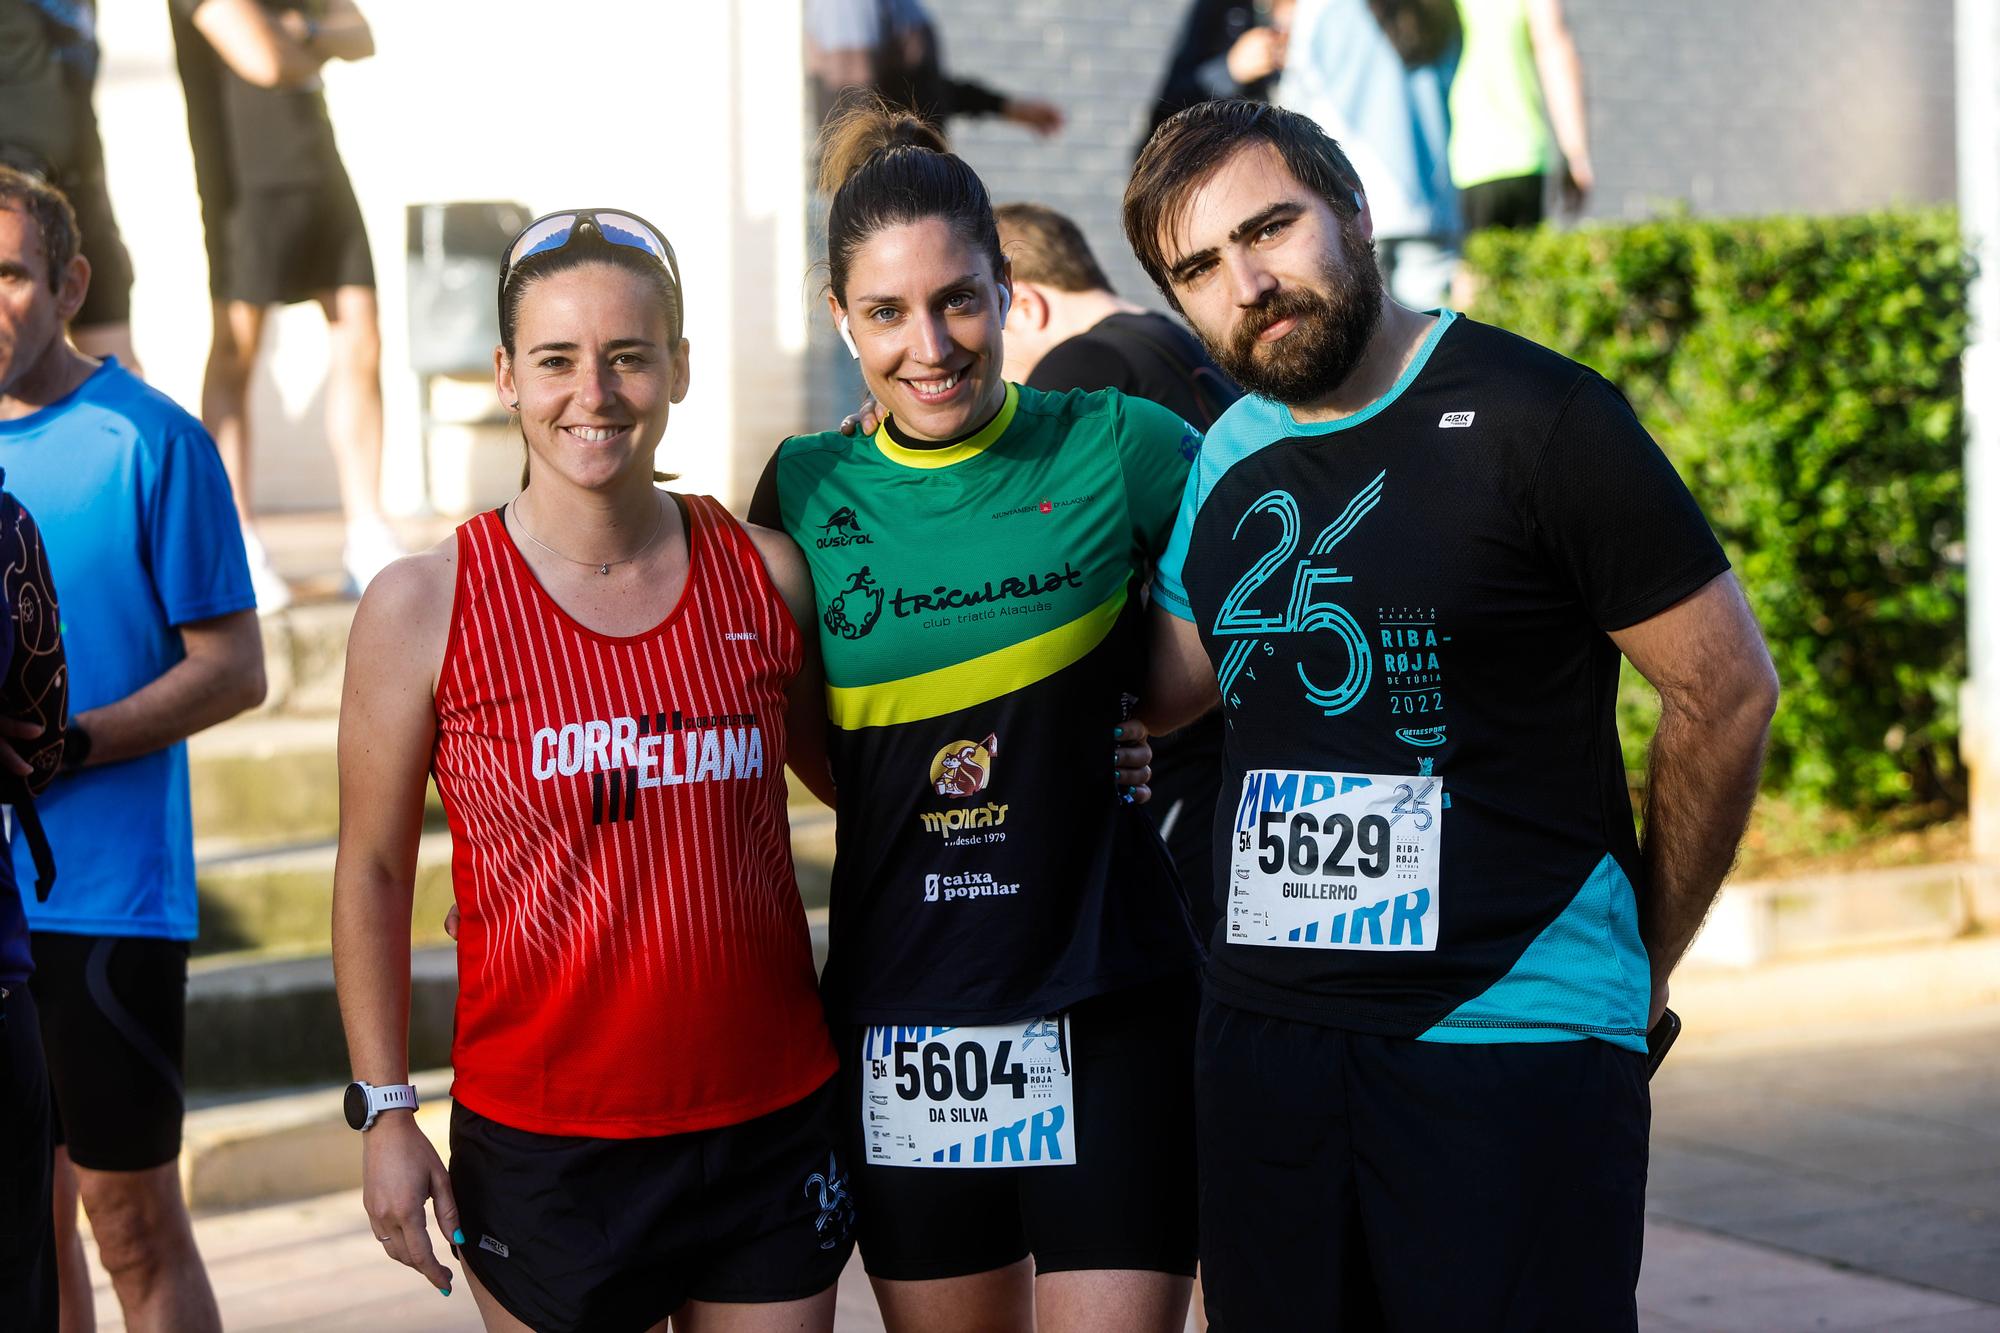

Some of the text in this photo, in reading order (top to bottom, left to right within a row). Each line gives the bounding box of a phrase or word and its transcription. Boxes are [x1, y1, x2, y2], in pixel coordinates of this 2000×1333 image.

[1444, 414, 1470, 422] 42K
[991, 505, 1038, 520] AJUNTAMENT
[922, 617, 951, 630] club
[999, 601, 1052, 617] Alaquàs
[1380, 629, 1452, 648] RIBA-
[1387, 676, 1400, 685] DE
[1390, 692, 1444, 714] 2022
[685, 716, 708, 729] CLUB
[531, 716, 764, 789] CORRELIANA
[984, 832, 1006, 844] 1979
[1258, 811, 1391, 879] 5629
[1396, 844, 1425, 854] RIBA-
[942, 872, 993, 886] caixa
[943, 882, 1021, 901] popular
[1282, 882, 1358, 901] GUILLERMO
[894, 1040, 1028, 1101] 5604
[1030, 1066, 1057, 1074] RIBA-
[929, 1107, 989, 1122] DA SILVA
